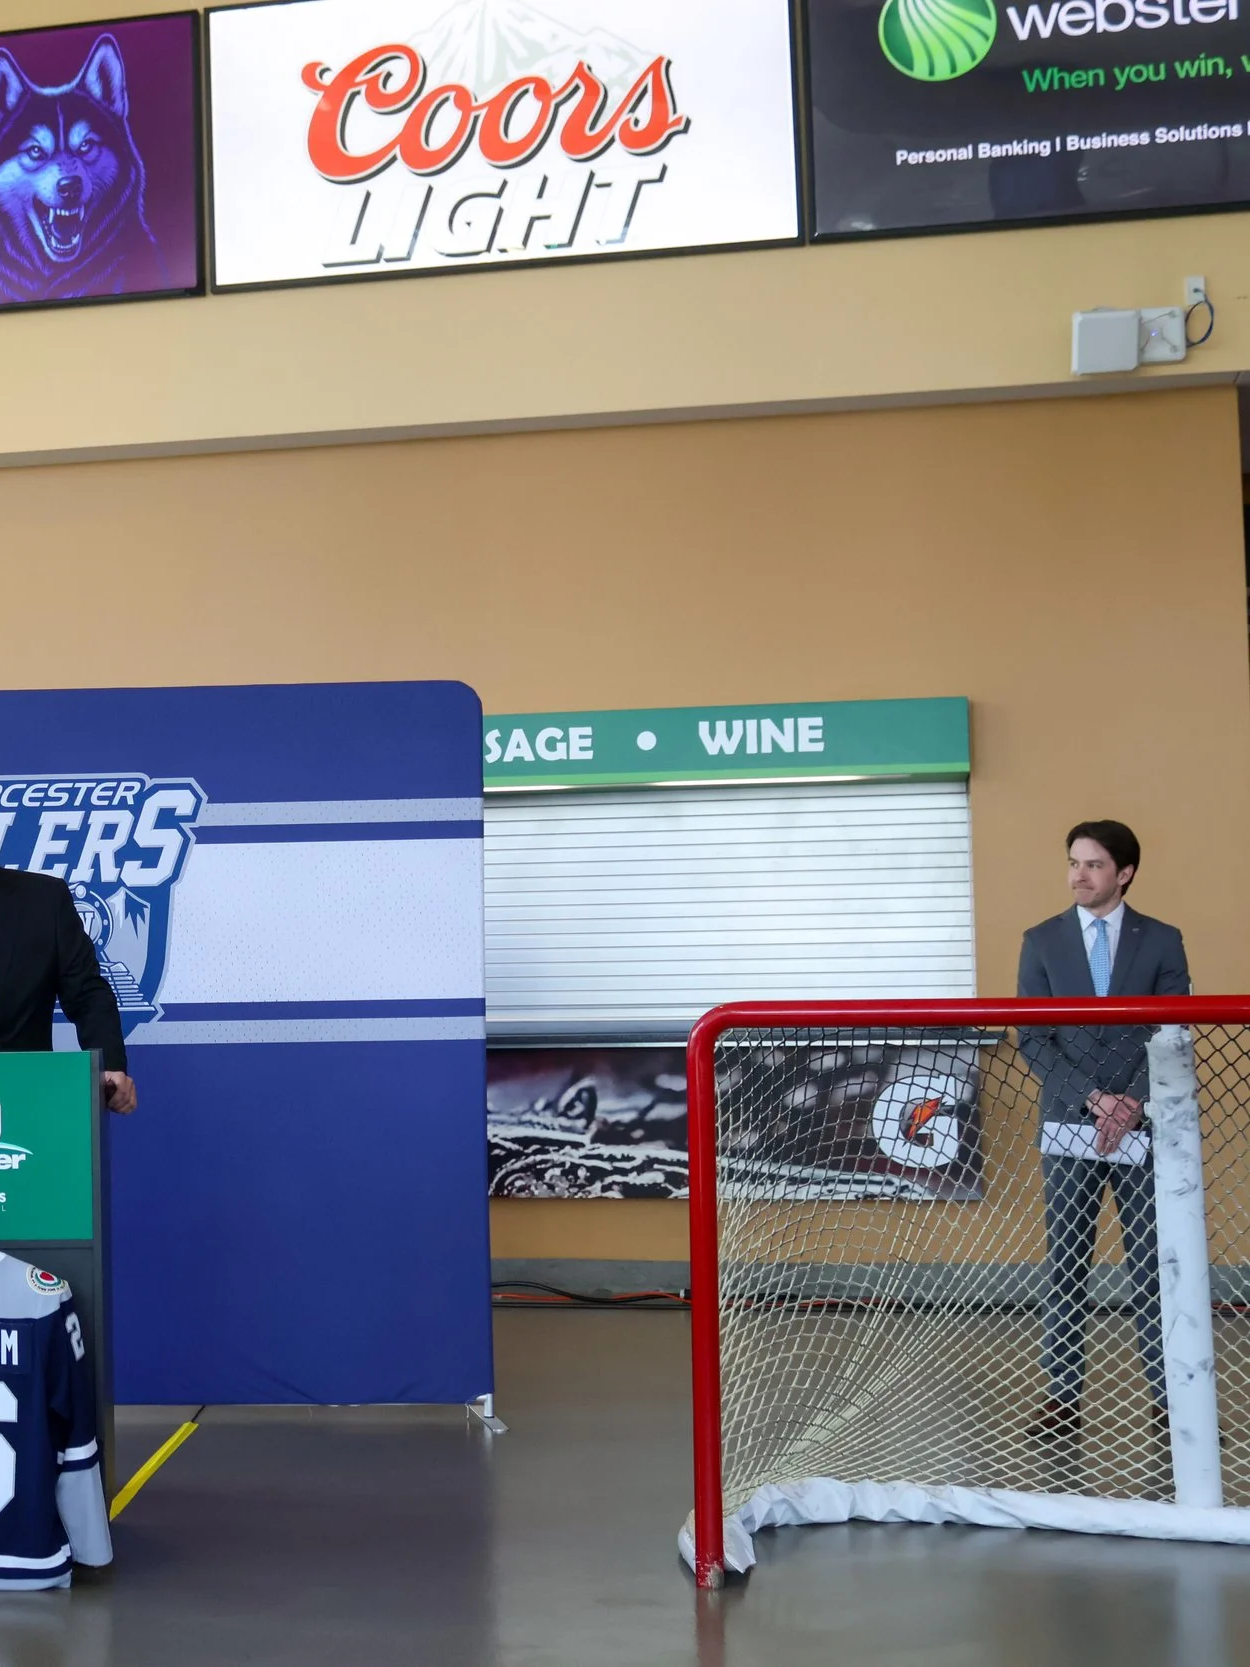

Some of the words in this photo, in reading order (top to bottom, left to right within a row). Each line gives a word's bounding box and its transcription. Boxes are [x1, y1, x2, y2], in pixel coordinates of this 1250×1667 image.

[1021, 65, 1106, 93] When
[1113, 61, 1167, 91] you
[1174, 52, 1233, 80] win,
[300, 43, 691, 185] Coors
[895, 144, 973, 166] Personal
[977, 138, 1051, 160] Banking
[1066, 131, 1150, 152] Business
[1154, 123, 1244, 144] Solutions
[321, 163, 668, 268] LIGHT
[484, 726, 594, 764] SAGE
[698, 716, 825, 756] WINE
